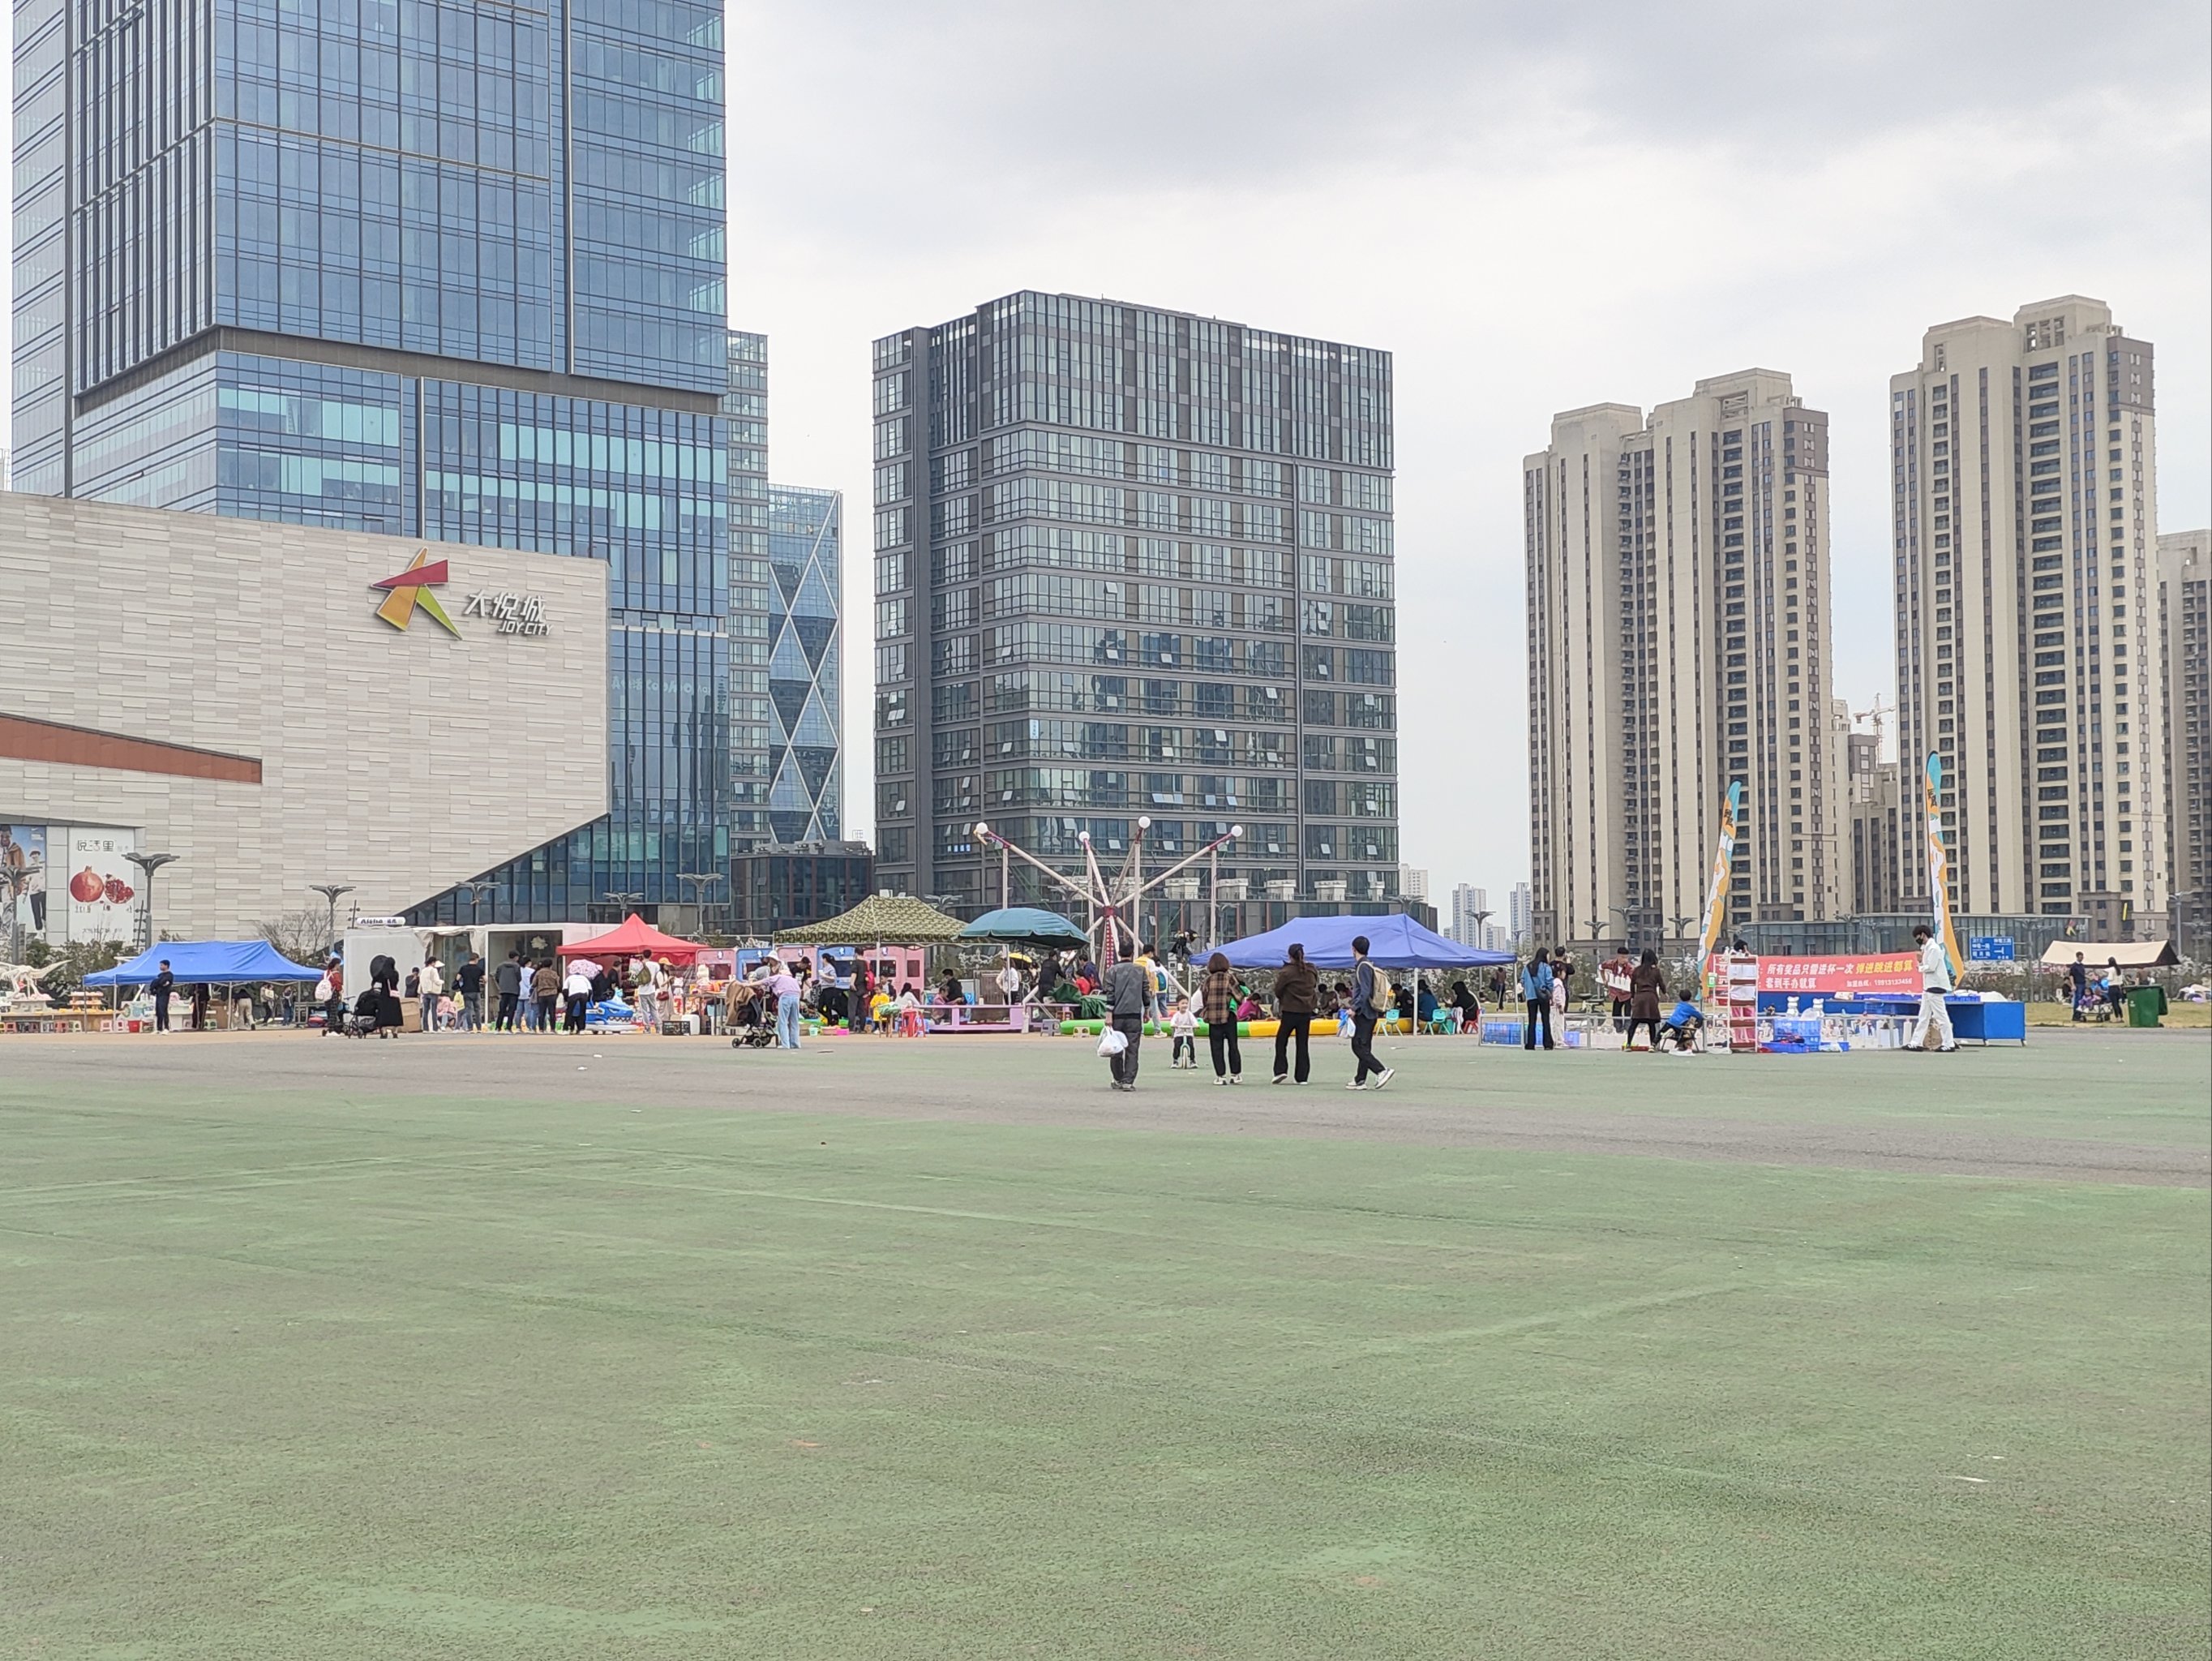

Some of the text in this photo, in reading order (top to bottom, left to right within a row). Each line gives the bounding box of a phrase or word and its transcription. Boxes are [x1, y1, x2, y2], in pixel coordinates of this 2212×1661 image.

[464, 590, 547, 622] 大悦城
[498, 620, 554, 636] JOY CITY
